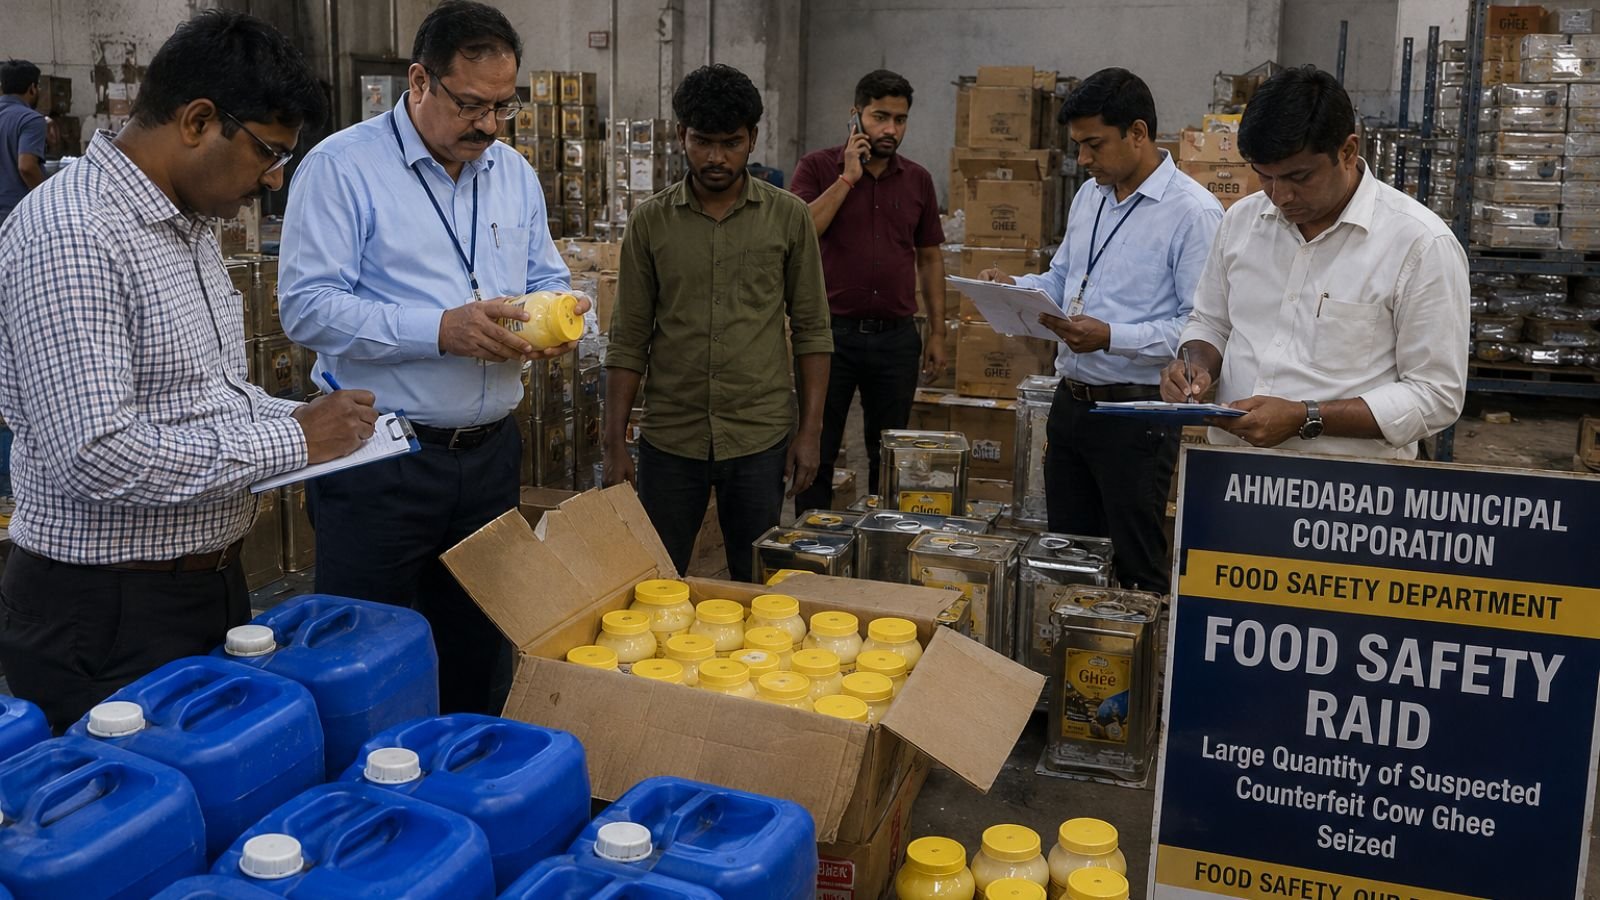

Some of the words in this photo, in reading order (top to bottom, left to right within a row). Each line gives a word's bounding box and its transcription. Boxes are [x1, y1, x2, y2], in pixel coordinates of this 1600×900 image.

[1500, 18, 1529, 30] GHEE
[991, 220, 1017, 231] GHEE
[984, 367, 1012, 379] GHEE
[1224, 473, 1395, 516] AHMEDABAD
[1403, 488, 1568, 532] MUNICIPAL
[1292, 518, 1496, 566] CORPORATION
[1215, 564, 1279, 591] FOOD
[1286, 571, 1380, 602] SAFETY
[1388, 581, 1562, 620] DEPARTMENT
[1204, 615, 1339, 675] FOOD
[1356, 633, 1566, 703] SAFETY
[1305, 689, 1431, 750] RAID
[1201, 736, 1265, 769] Large
[1272, 746, 1371, 787] Quantity
[1378, 763, 1403, 786] of
[1409, 766, 1541, 807] Suspected
[1236, 776, 1365, 819] Counterfeit
[1373, 796, 1425, 826] Cow
[1432, 806, 1496, 837] Ghee
[1317, 825, 1396, 859] Seized
[1195, 861, 1252, 889] FOOD
